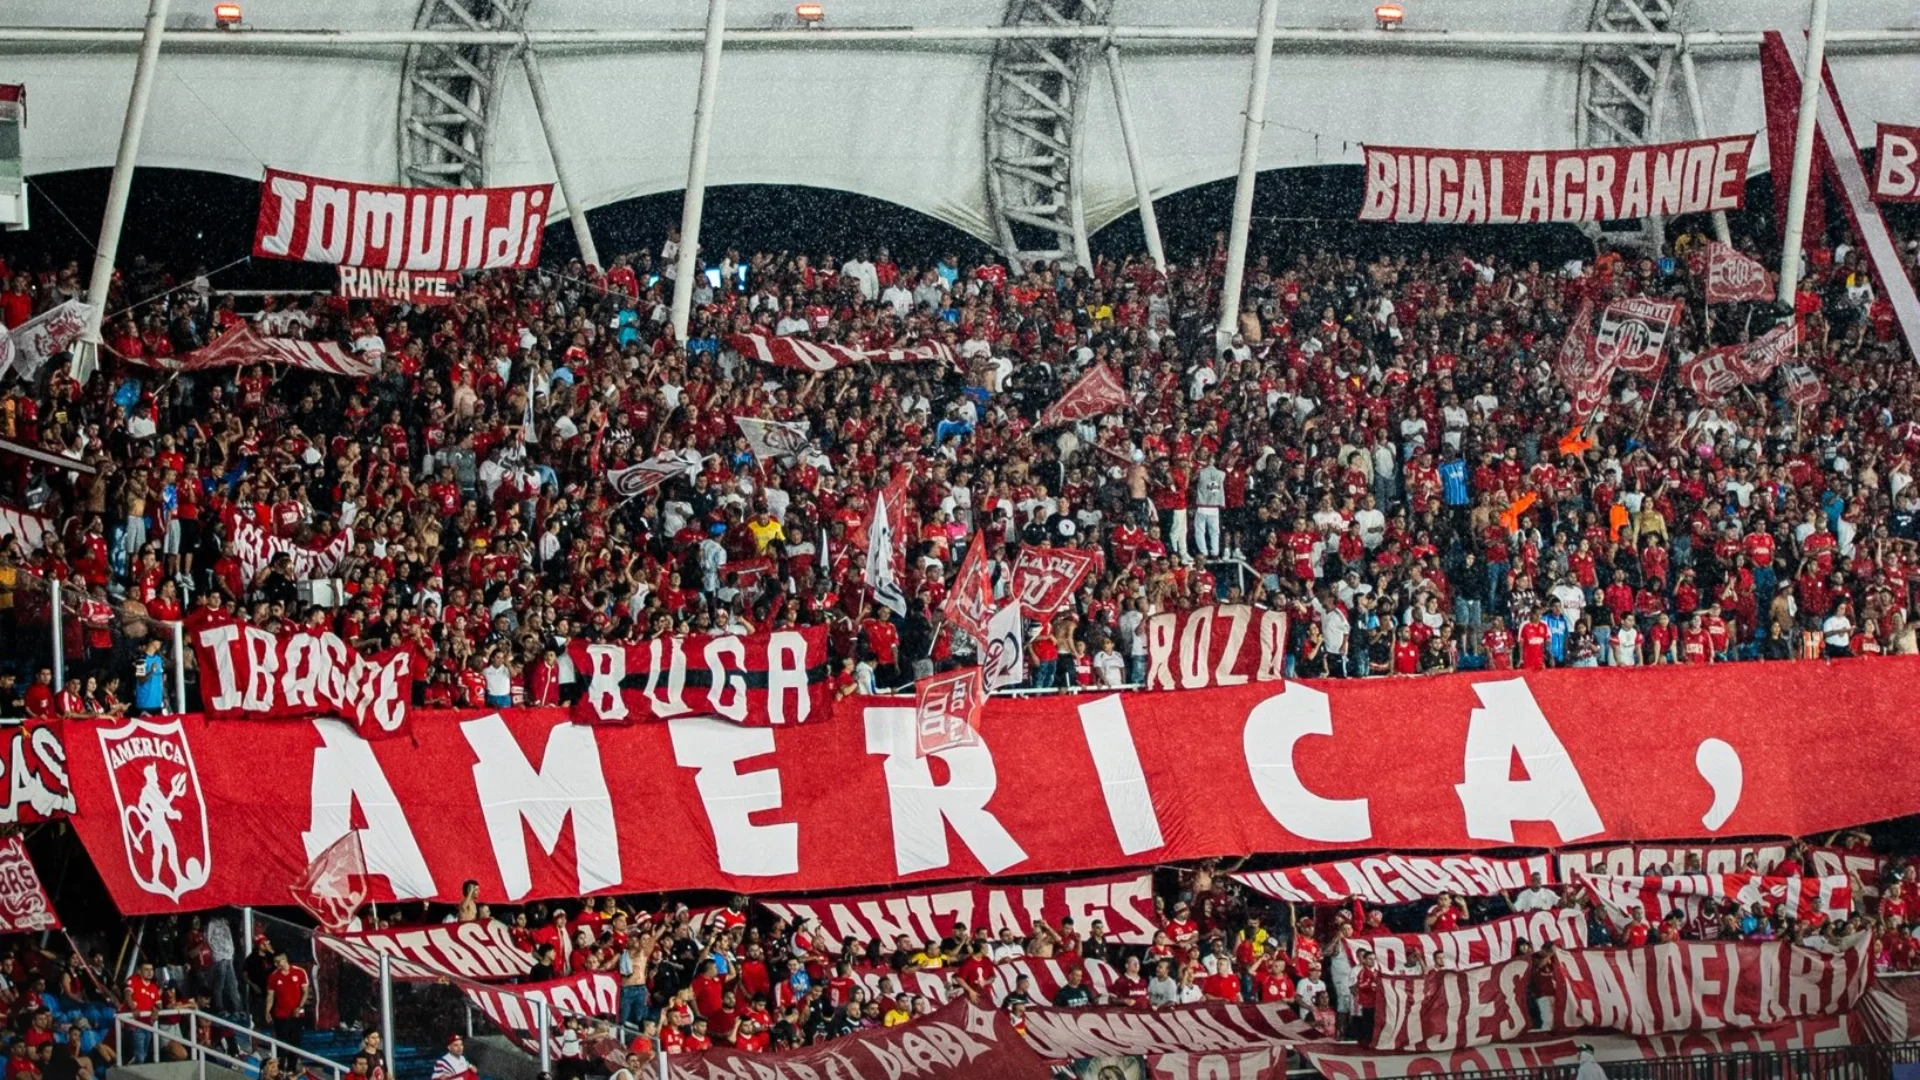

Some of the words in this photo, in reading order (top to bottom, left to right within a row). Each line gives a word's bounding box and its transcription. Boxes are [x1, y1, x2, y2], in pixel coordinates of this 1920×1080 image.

[1360, 140, 1751, 223] BUGALAGRANDE
[1877, 133, 1920, 197] B
[340, 265, 410, 300] RAMA
[586, 631, 811, 724] BUGA
[1147, 604, 1287, 690] ROZO
[0, 727, 77, 823] AS
[110, 737, 186, 770] AMERICA
